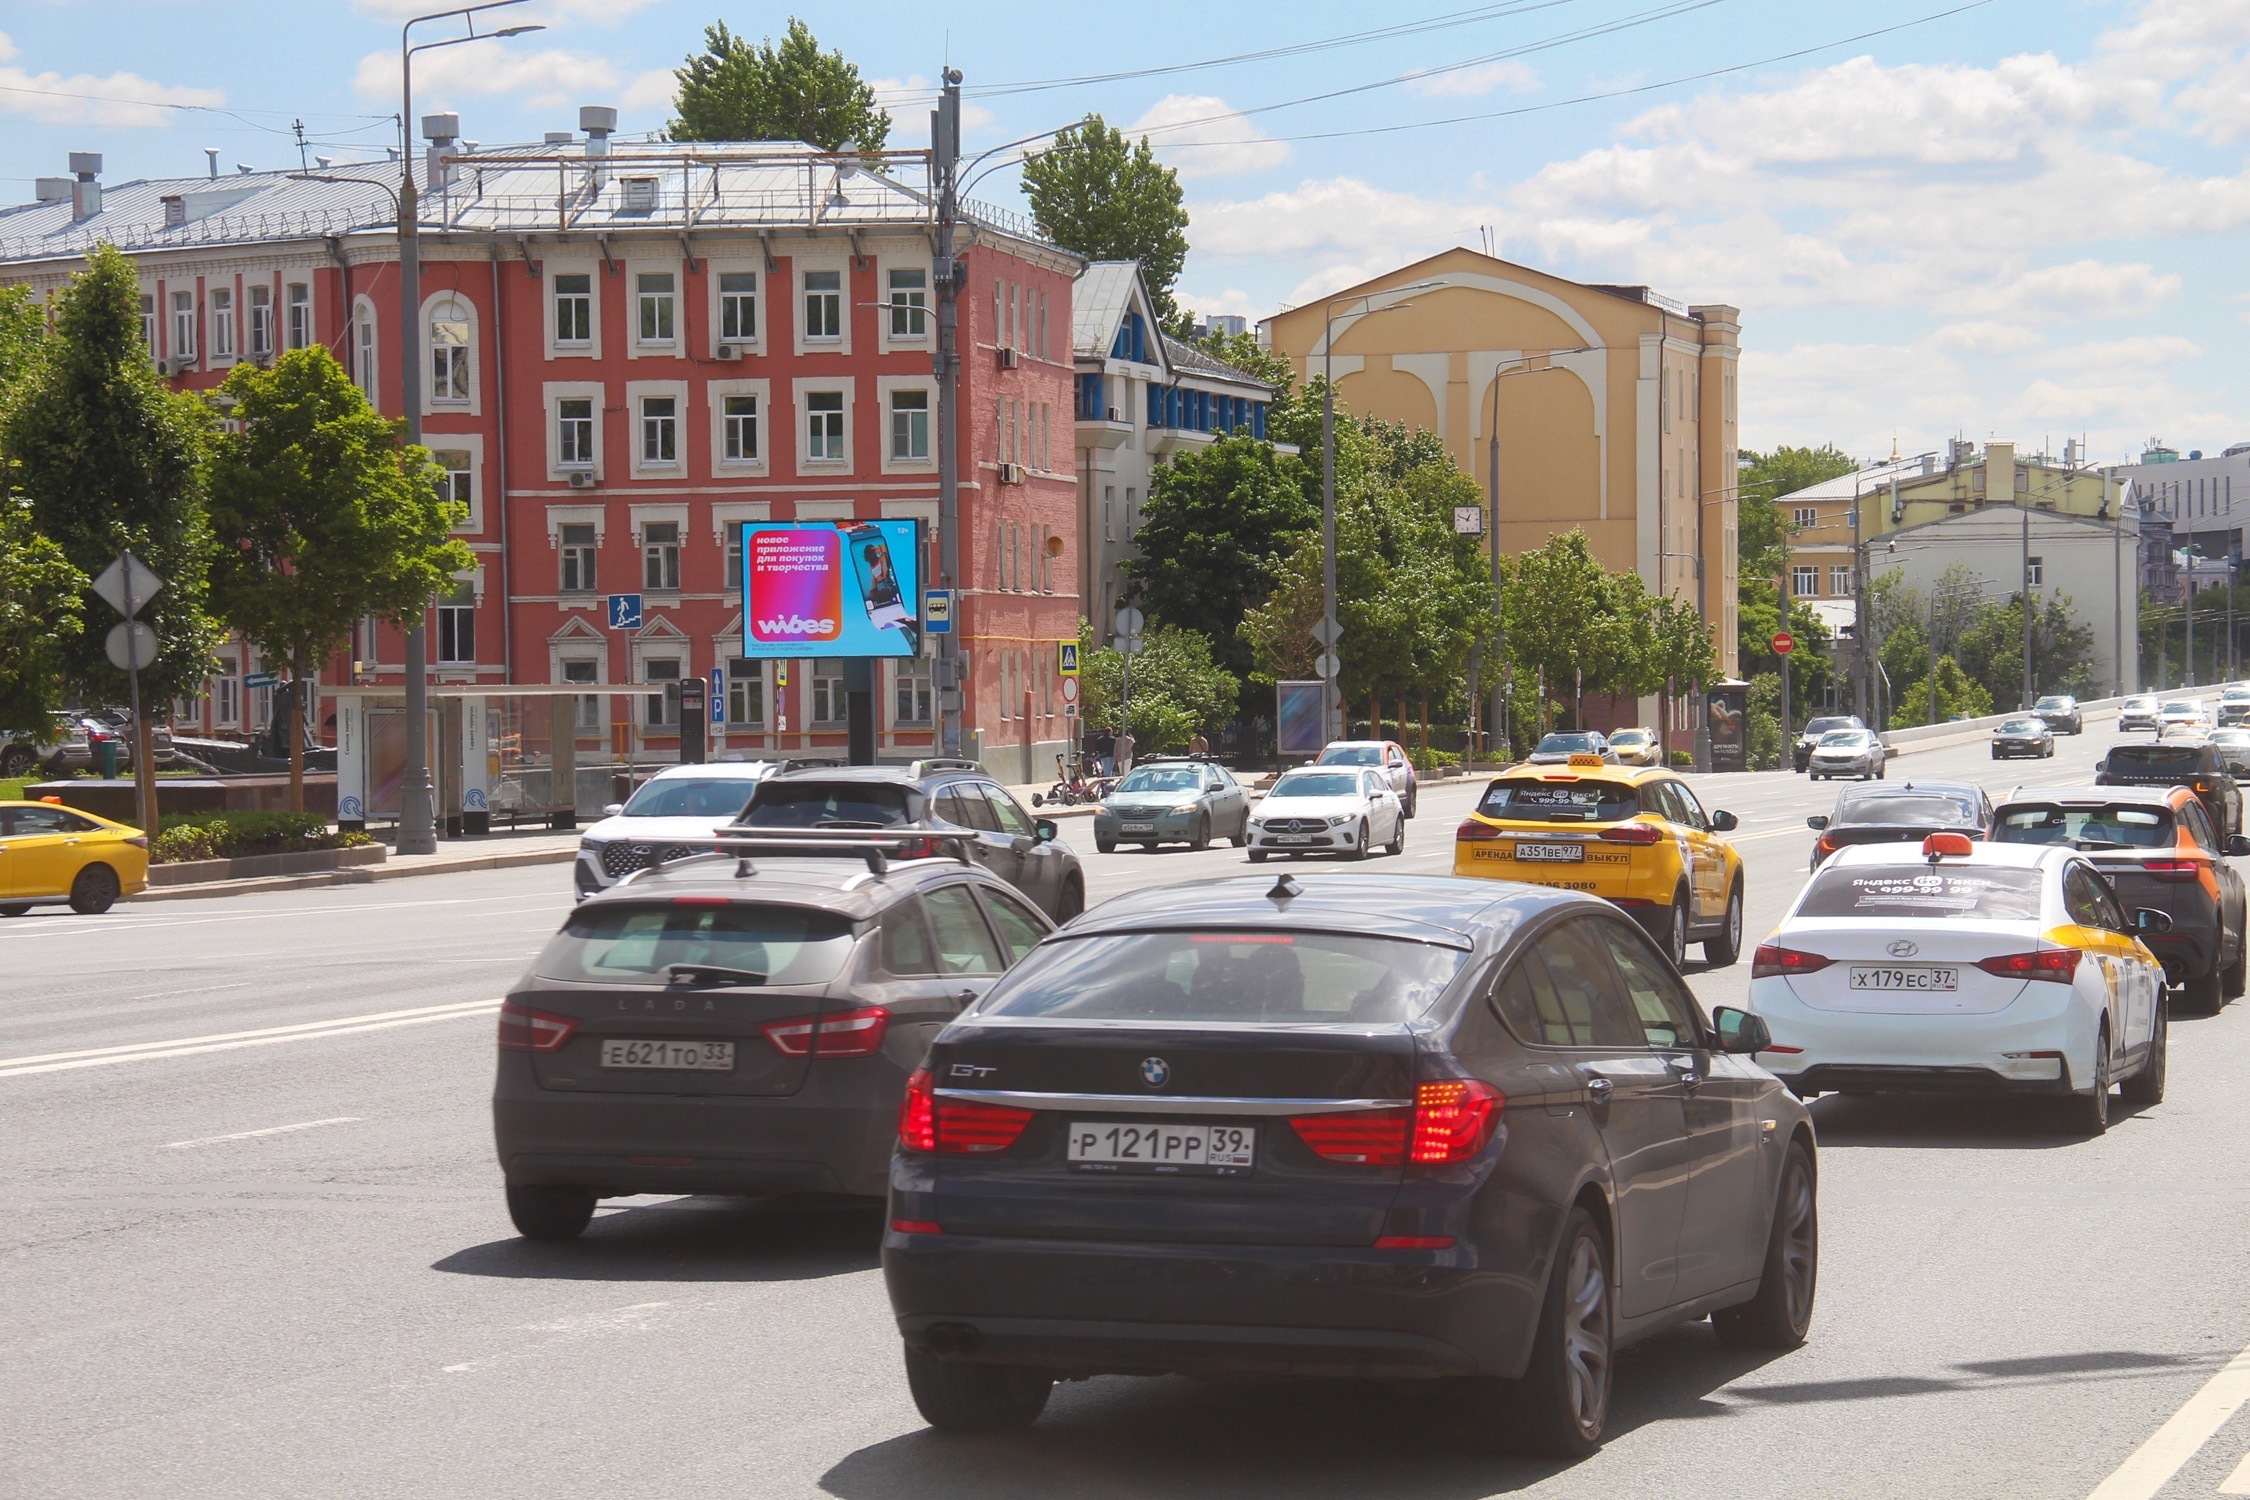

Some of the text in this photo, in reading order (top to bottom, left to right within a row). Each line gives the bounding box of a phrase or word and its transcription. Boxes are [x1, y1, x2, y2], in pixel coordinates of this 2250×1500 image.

[756, 536, 790, 544] новое
[756, 545, 825, 555] приложение
[756, 555, 825, 564] для покупок
[766, 564, 829, 573] творчества
[757, 614, 835, 635] wibes
[1519, 790, 1551, 798] Яндекс
[1474, 850, 1513, 860] АРЕНДА
[1519, 845, 1579, 858] А351ВЕ 977
[1586, 853, 1628, 863] ВЫКУП
[1564, 881, 1597, 890] 3080
[1853, 878, 1911, 886] Яндекс
[1945, 877, 1992, 886] Такси
[1857, 970, 1951, 988] Х179ЕС 37
[618, 999, 714, 1011] LADA
[610, 1042, 726, 1065] Е621ТО 33
[950, 1063, 997, 1078] GT
[1079, 1126, 1244, 1160] Р121РР 39
[1209, 1153, 1233, 1163] RUS
